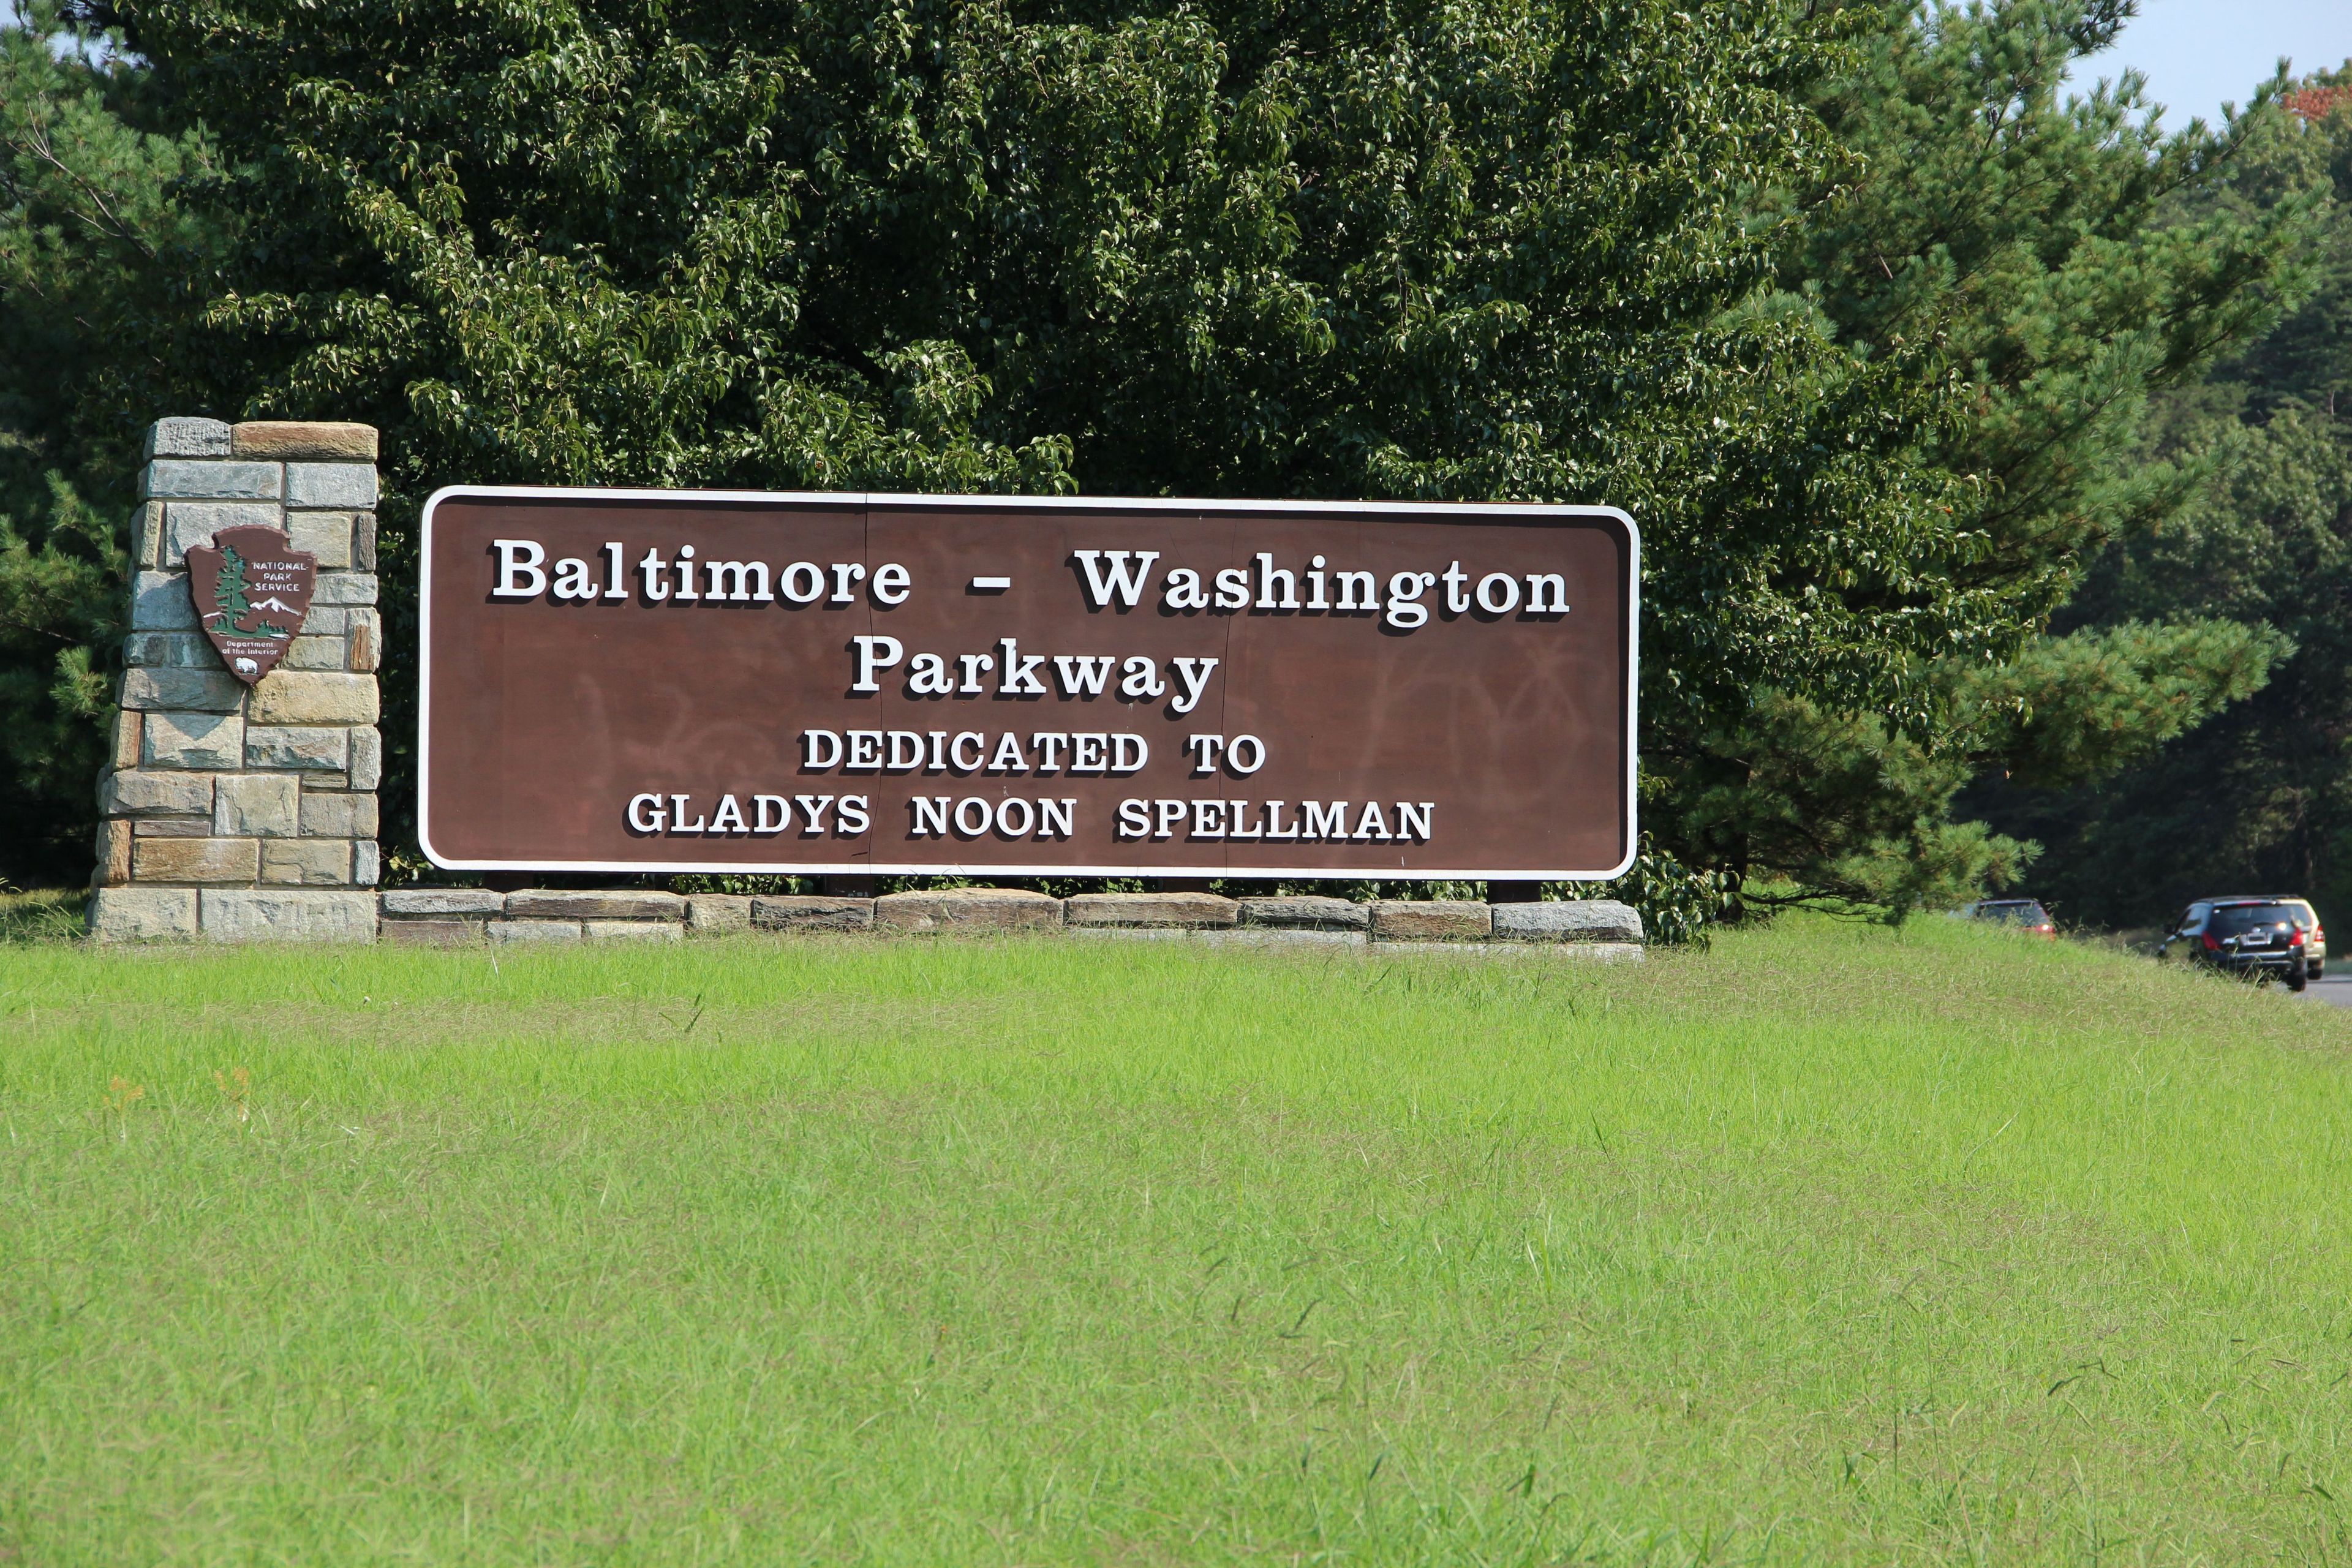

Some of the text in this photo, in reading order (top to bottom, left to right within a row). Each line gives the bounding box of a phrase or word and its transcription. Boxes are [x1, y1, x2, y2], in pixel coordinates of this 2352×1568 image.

[252, 562, 307, 571] NATIONAL
[254, 582, 300, 592] SERVICE
[263, 572, 292, 581] PARK
[493, 539, 911, 605] Baltimore
[1074, 550, 1570, 628] Washington
[853, 635, 1219, 713] Parkway
[804, 729, 1265, 773] DEDICATED TO
[628, 793, 1435, 839] GLADYS NOON SPELLMAN
